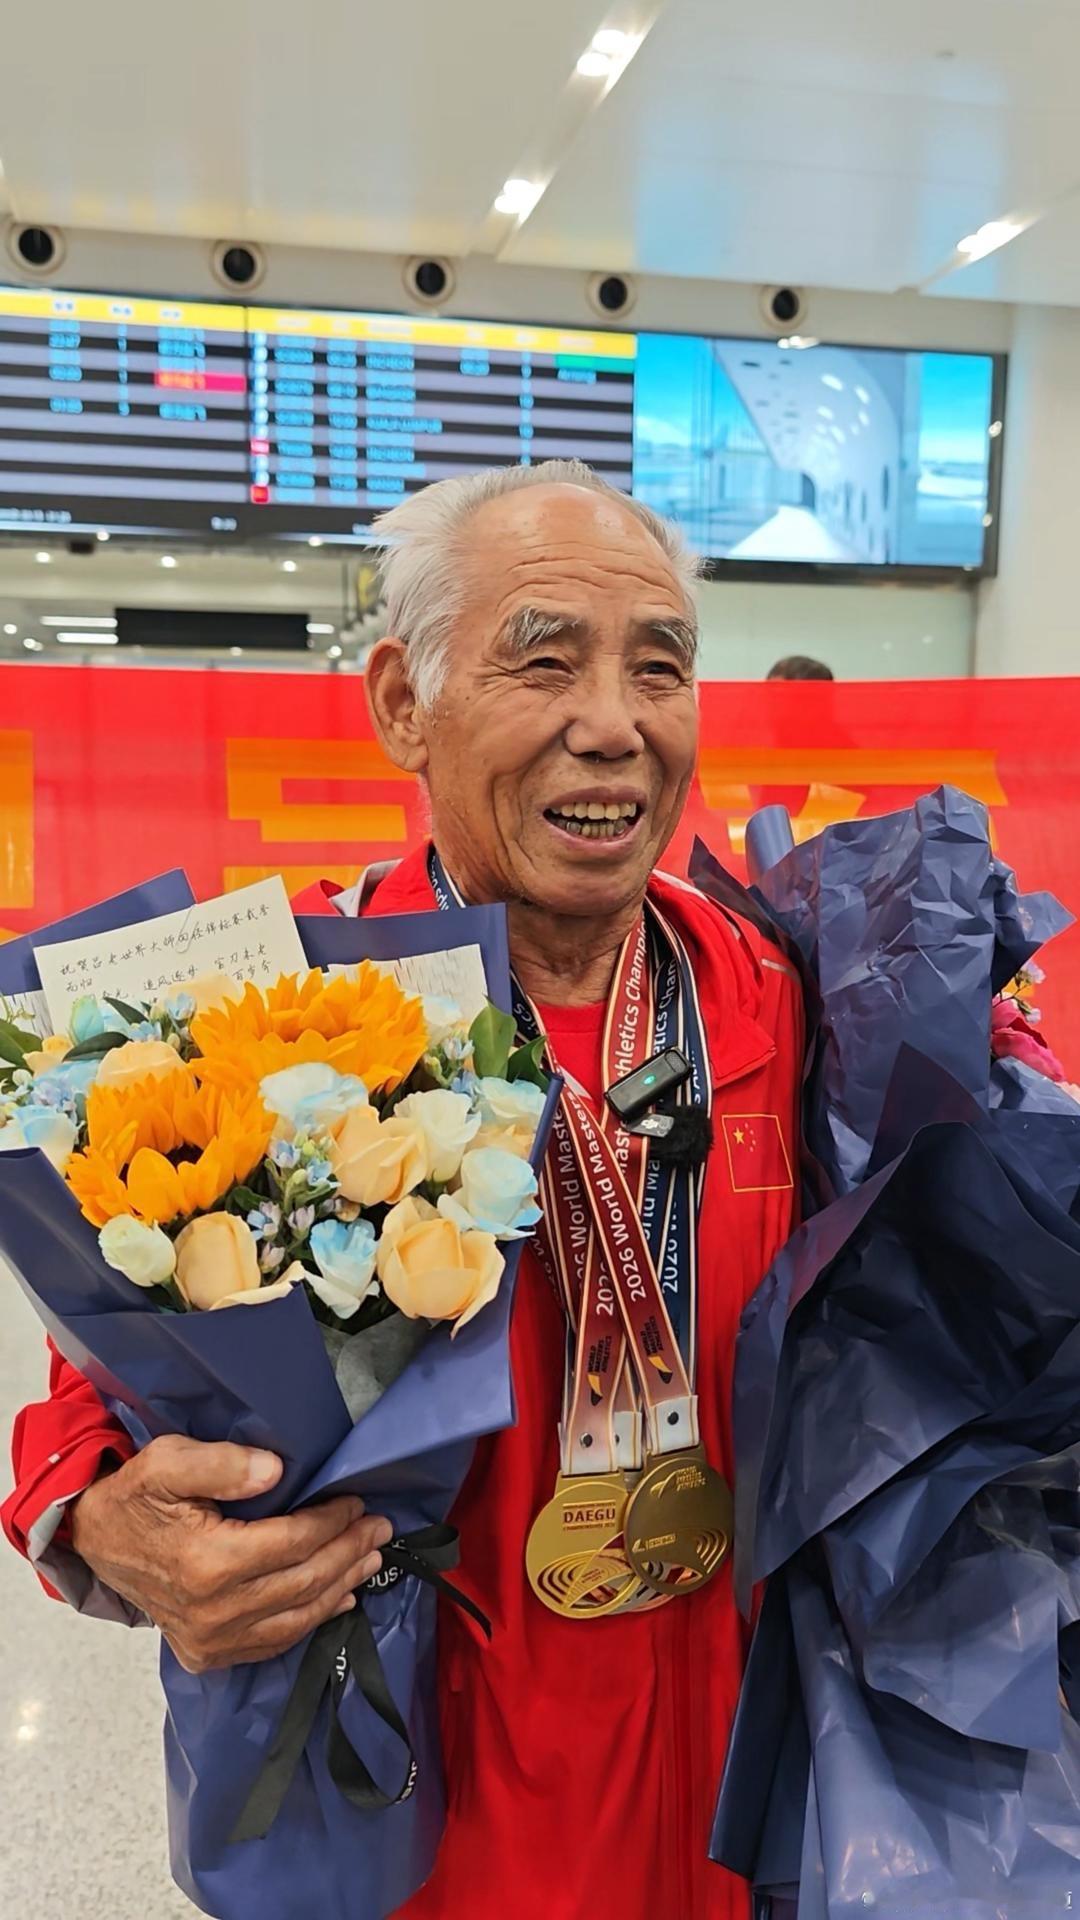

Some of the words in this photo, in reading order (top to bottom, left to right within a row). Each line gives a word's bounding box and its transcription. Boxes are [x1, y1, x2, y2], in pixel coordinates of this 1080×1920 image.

[615, 1006, 639, 1082] thletics
[569, 1093, 607, 1174] Masters
[561, 1179, 587, 1248] World
[596, 1177, 630, 1246] World
[619, 1246, 647, 1302] 2026
[563, 1508, 616, 1523] DAEGU
[366, 1564, 404, 1590] JUS
